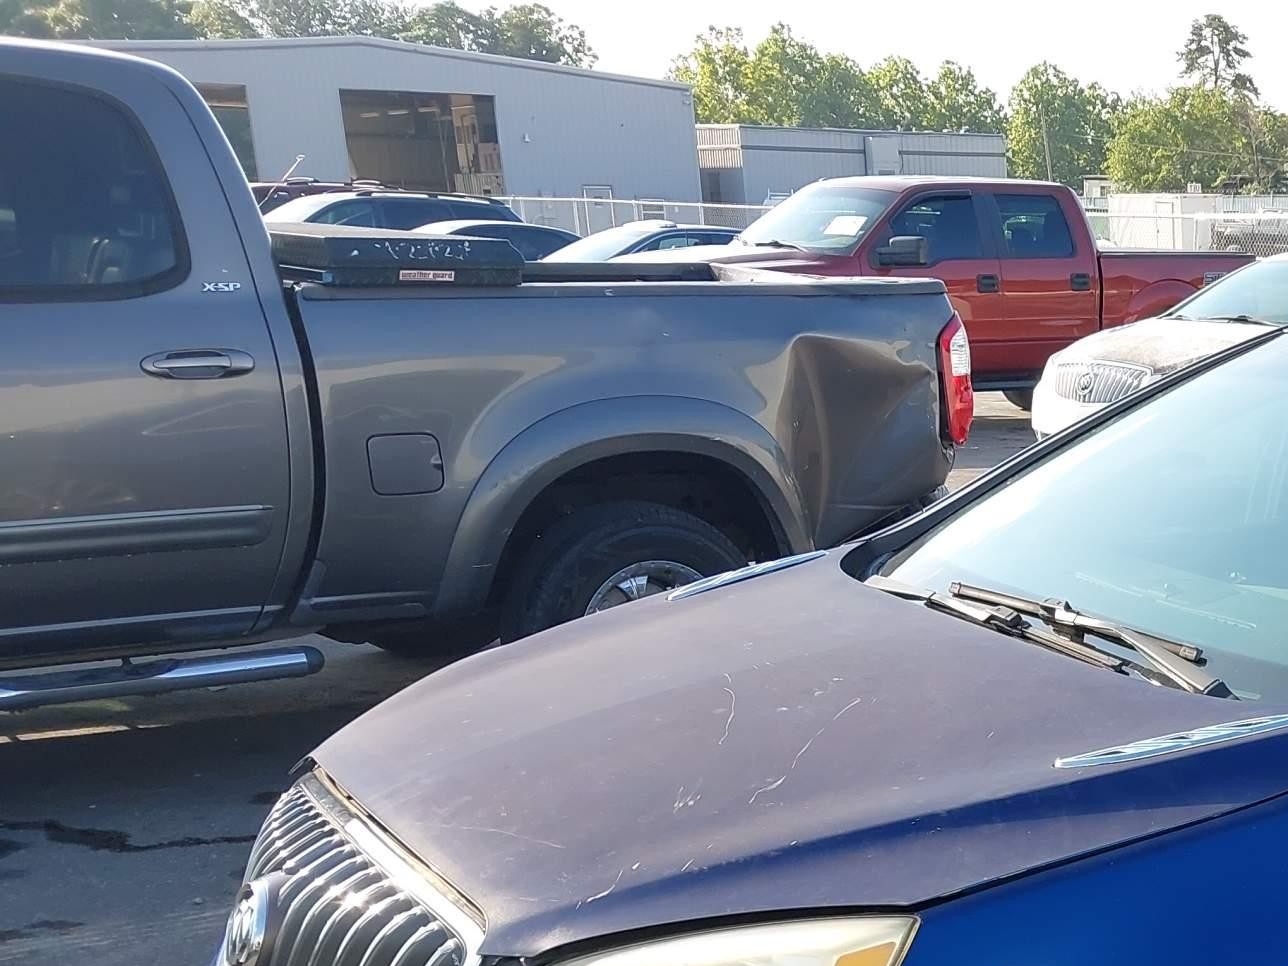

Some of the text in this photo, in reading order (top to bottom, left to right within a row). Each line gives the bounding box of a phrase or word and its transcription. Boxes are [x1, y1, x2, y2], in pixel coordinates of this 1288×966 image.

[401, 271, 453, 280] weather guard
[202, 282, 241, 292] X-SP
